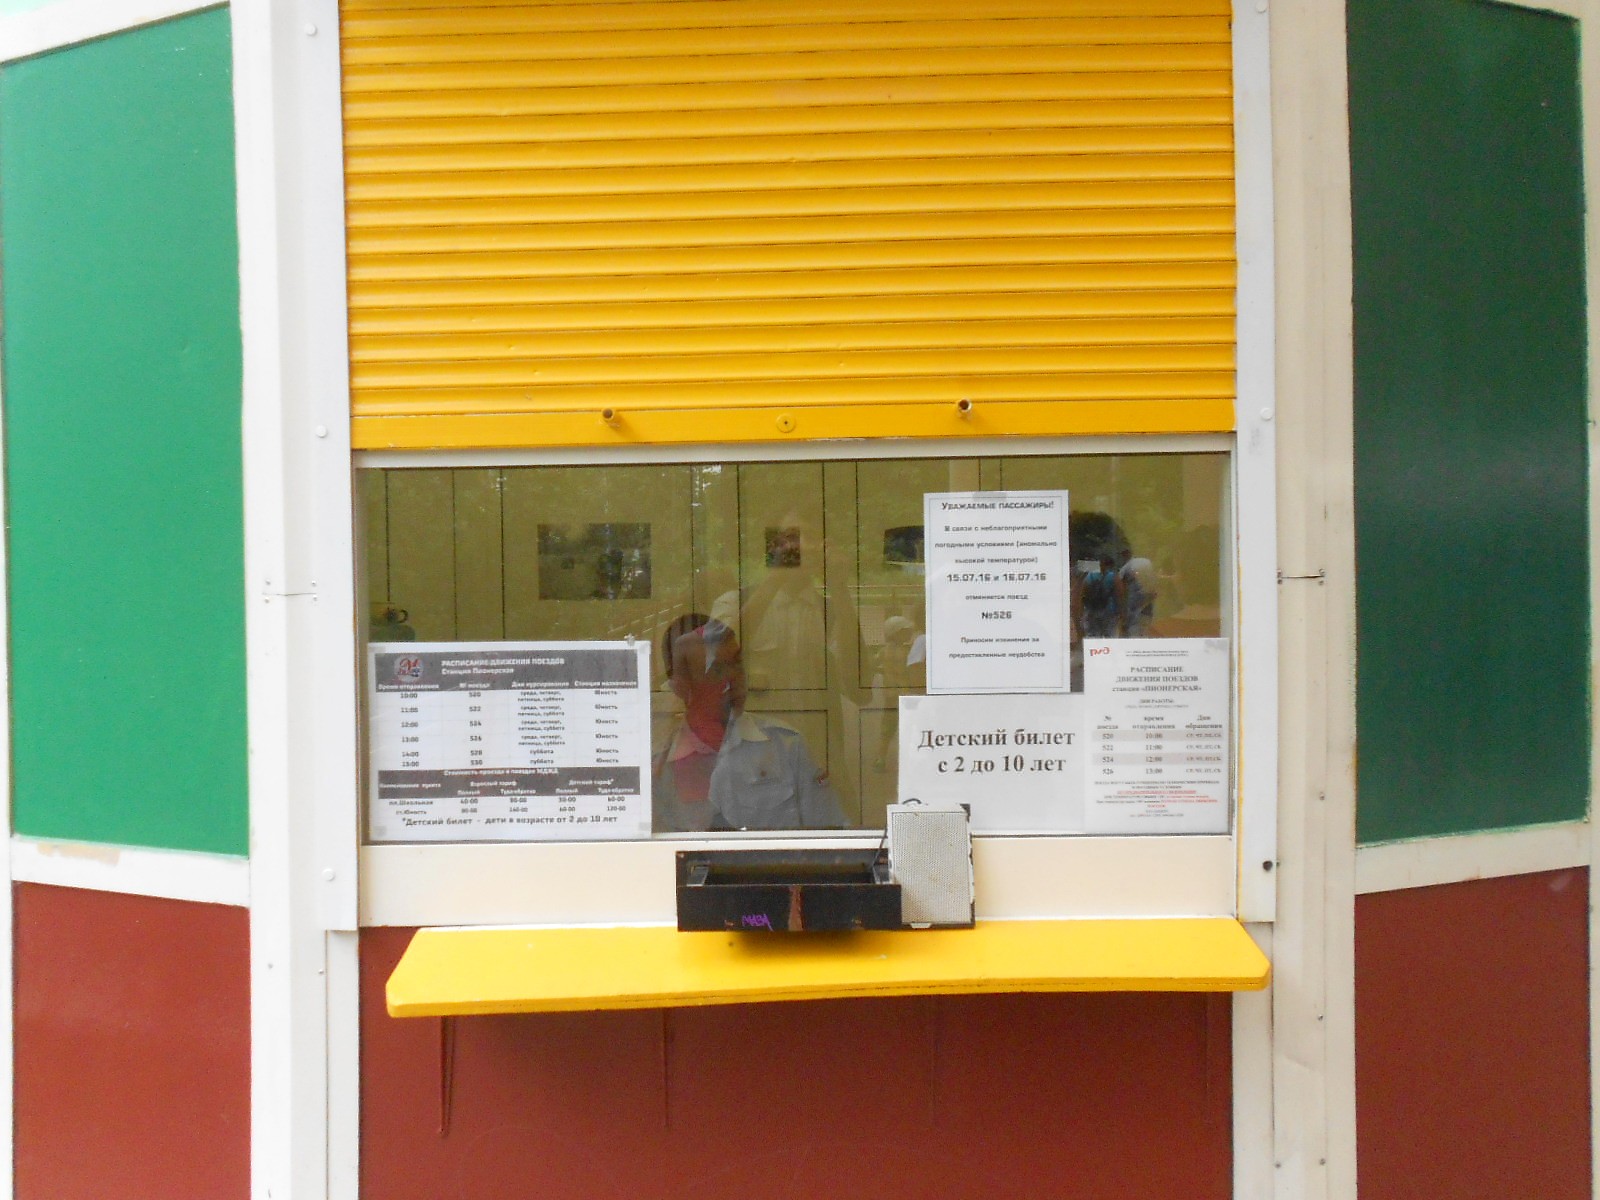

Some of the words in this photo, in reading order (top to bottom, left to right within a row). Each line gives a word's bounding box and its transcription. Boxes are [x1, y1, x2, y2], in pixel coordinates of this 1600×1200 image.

[947, 573, 990, 582] 15.07.16
[1003, 573, 1046, 582] 16.07.16
[981, 611, 1012, 620] №526
[1008, 651, 1045, 659] неудобства
[441, 658, 488, 667] РАСПИСАНИЕ
[490, 658, 530, 666] ДВИЖЕНИЯ
[532, 657, 565, 665] ПОЕЗДОВ
[1162, 675, 1199, 683] ПОЕЗДОВ
[918, 729, 1007, 750] Детский
[1014, 728, 1076, 746] билет
[938, 760, 948, 773] с
[953, 756, 965, 772] 2
[970, 760, 994, 774] до
[1002, 755, 1024, 772] 10
[1030, 759, 1066, 772] лет
[516, 817, 554, 826] возрасте
